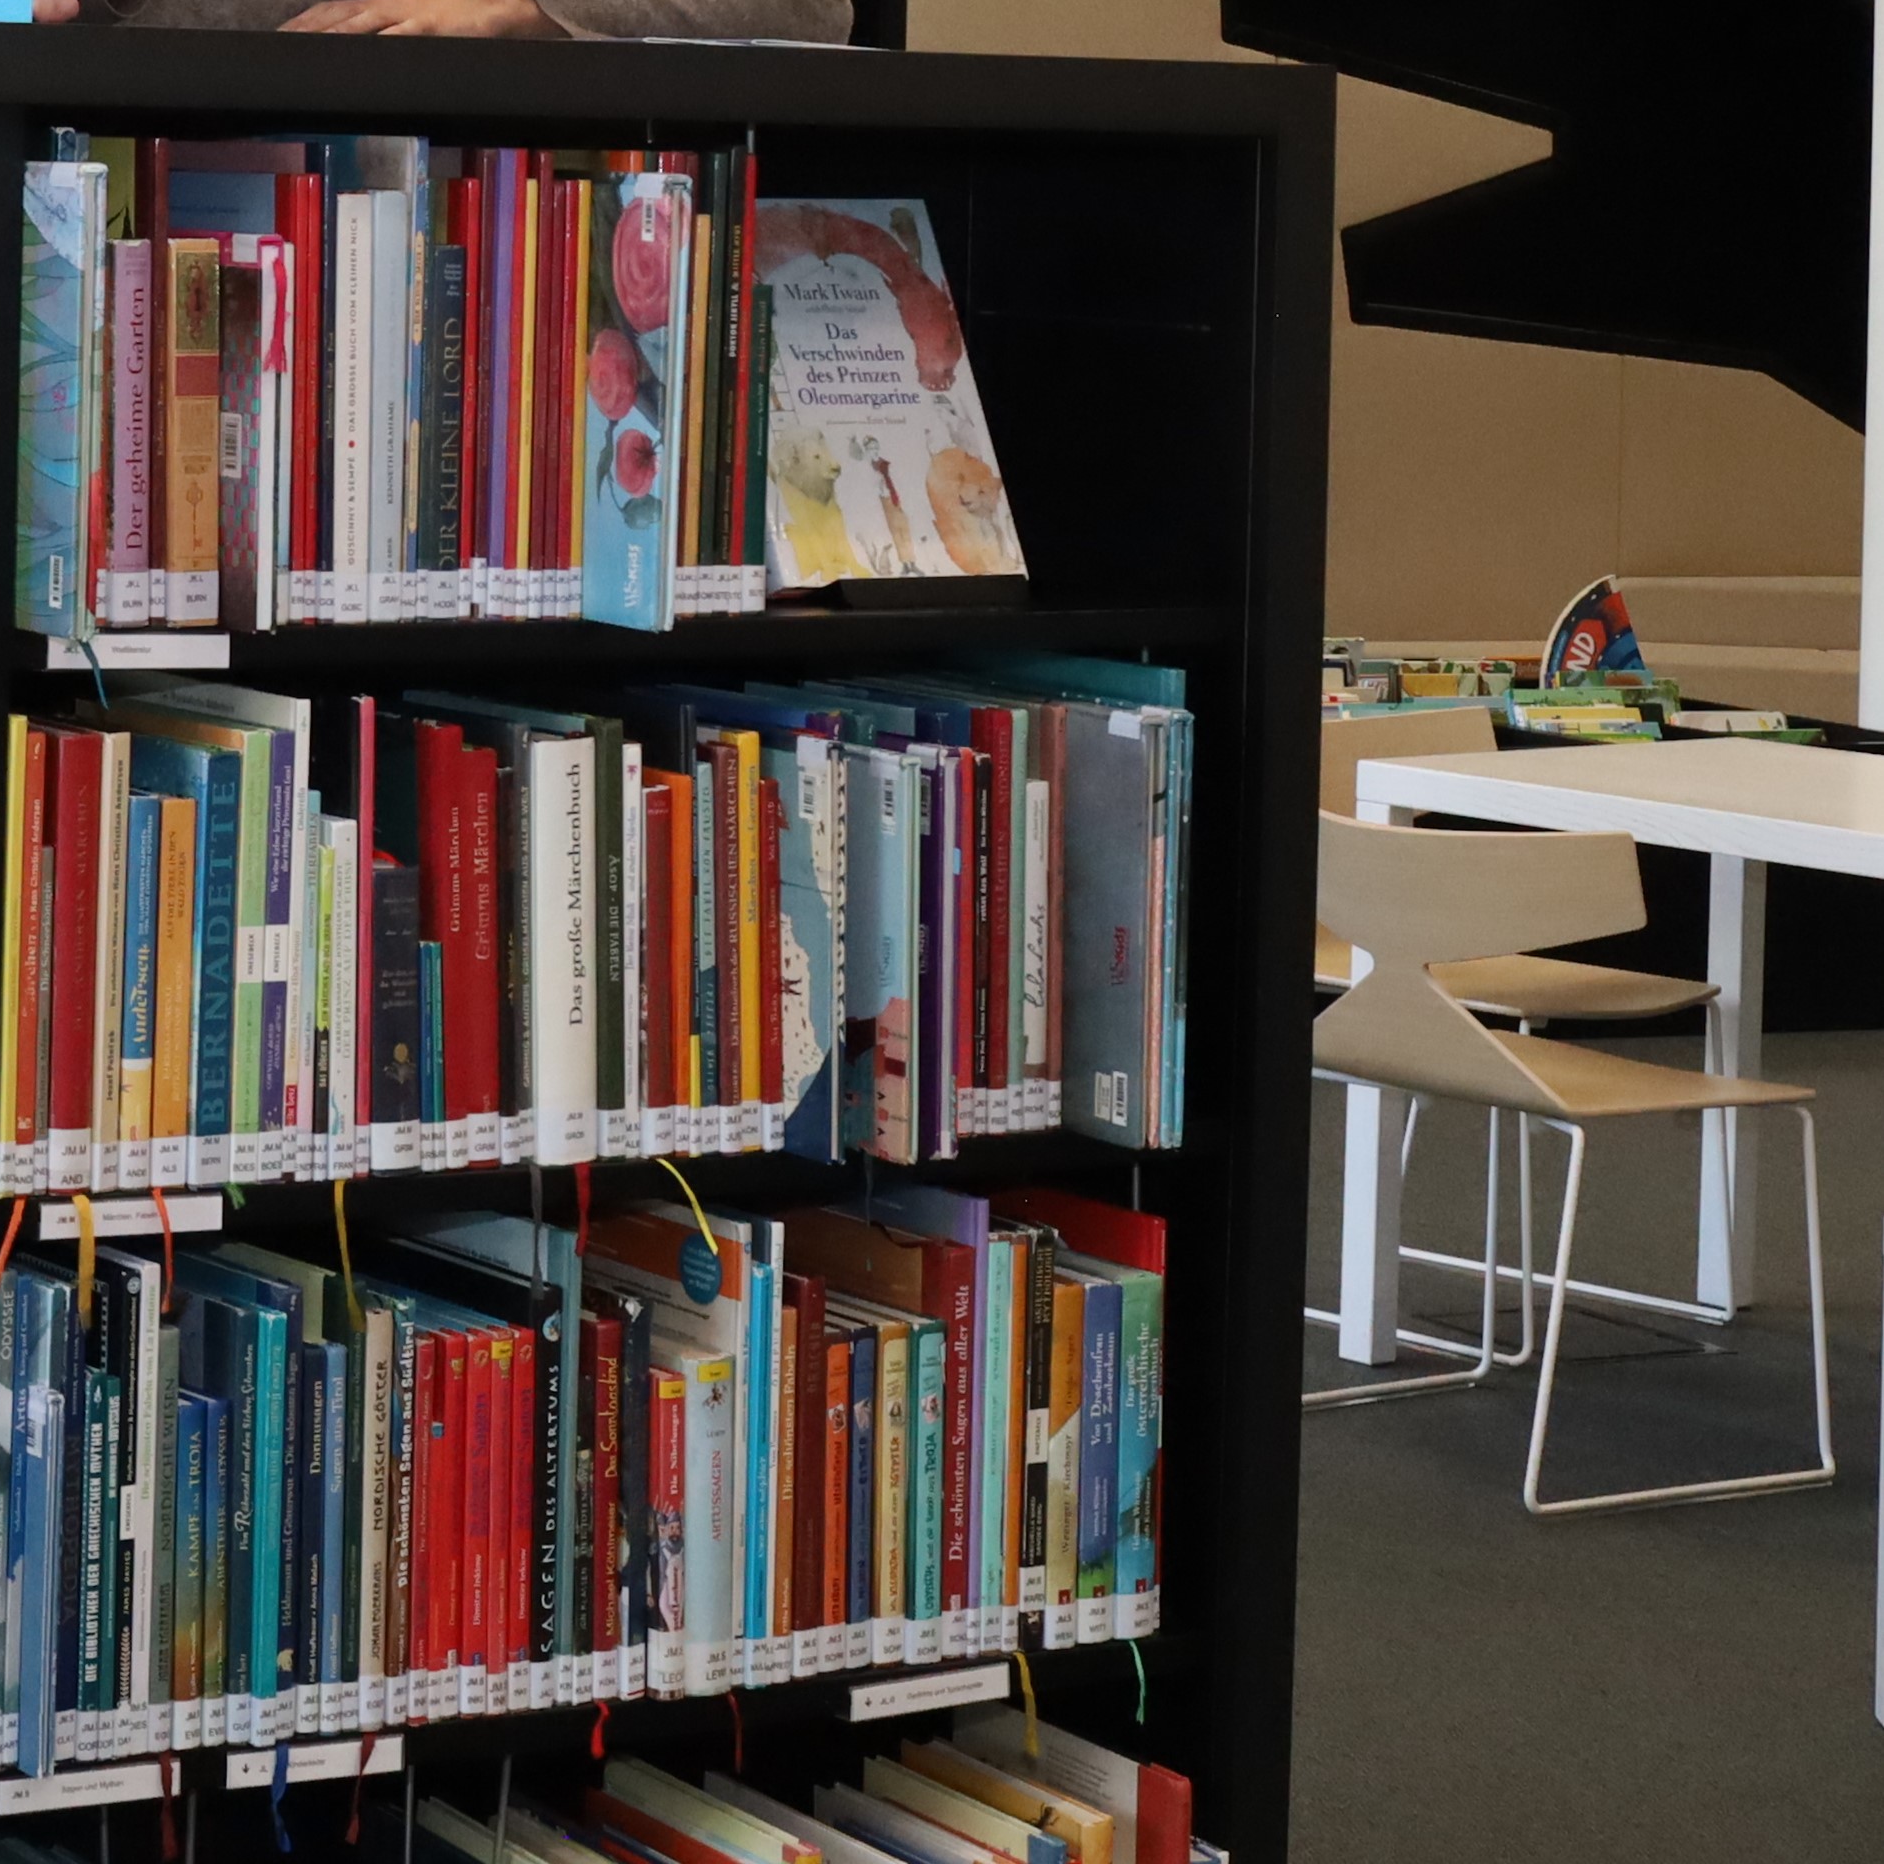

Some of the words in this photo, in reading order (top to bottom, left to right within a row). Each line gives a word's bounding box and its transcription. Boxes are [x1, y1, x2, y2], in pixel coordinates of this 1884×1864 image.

[785, 283, 829, 301] Mark
[830, 284, 880, 301] Twain
[126, 287, 145, 377] Garten
[789, 344, 905, 362] Verschwinden
[825, 323, 858, 340] Das
[798, 388, 922, 409] Oleomargarine
[806, 366, 833, 384] des
[837, 366, 901, 384] Prinzen
[125, 384, 148, 495] geheime
[125, 497, 144, 551] Der
[565, 763, 583, 909] Märchenbuch
[201, 781, 236, 1127] BERNADETTE
[571, 916, 586, 979] große
[569, 984, 585, 1026] Das
[546, 1364, 560, 1488] ALTERTUMS
[546, 1491, 556, 1532] DES
[540, 1543, 556, 1654] SAGEN
